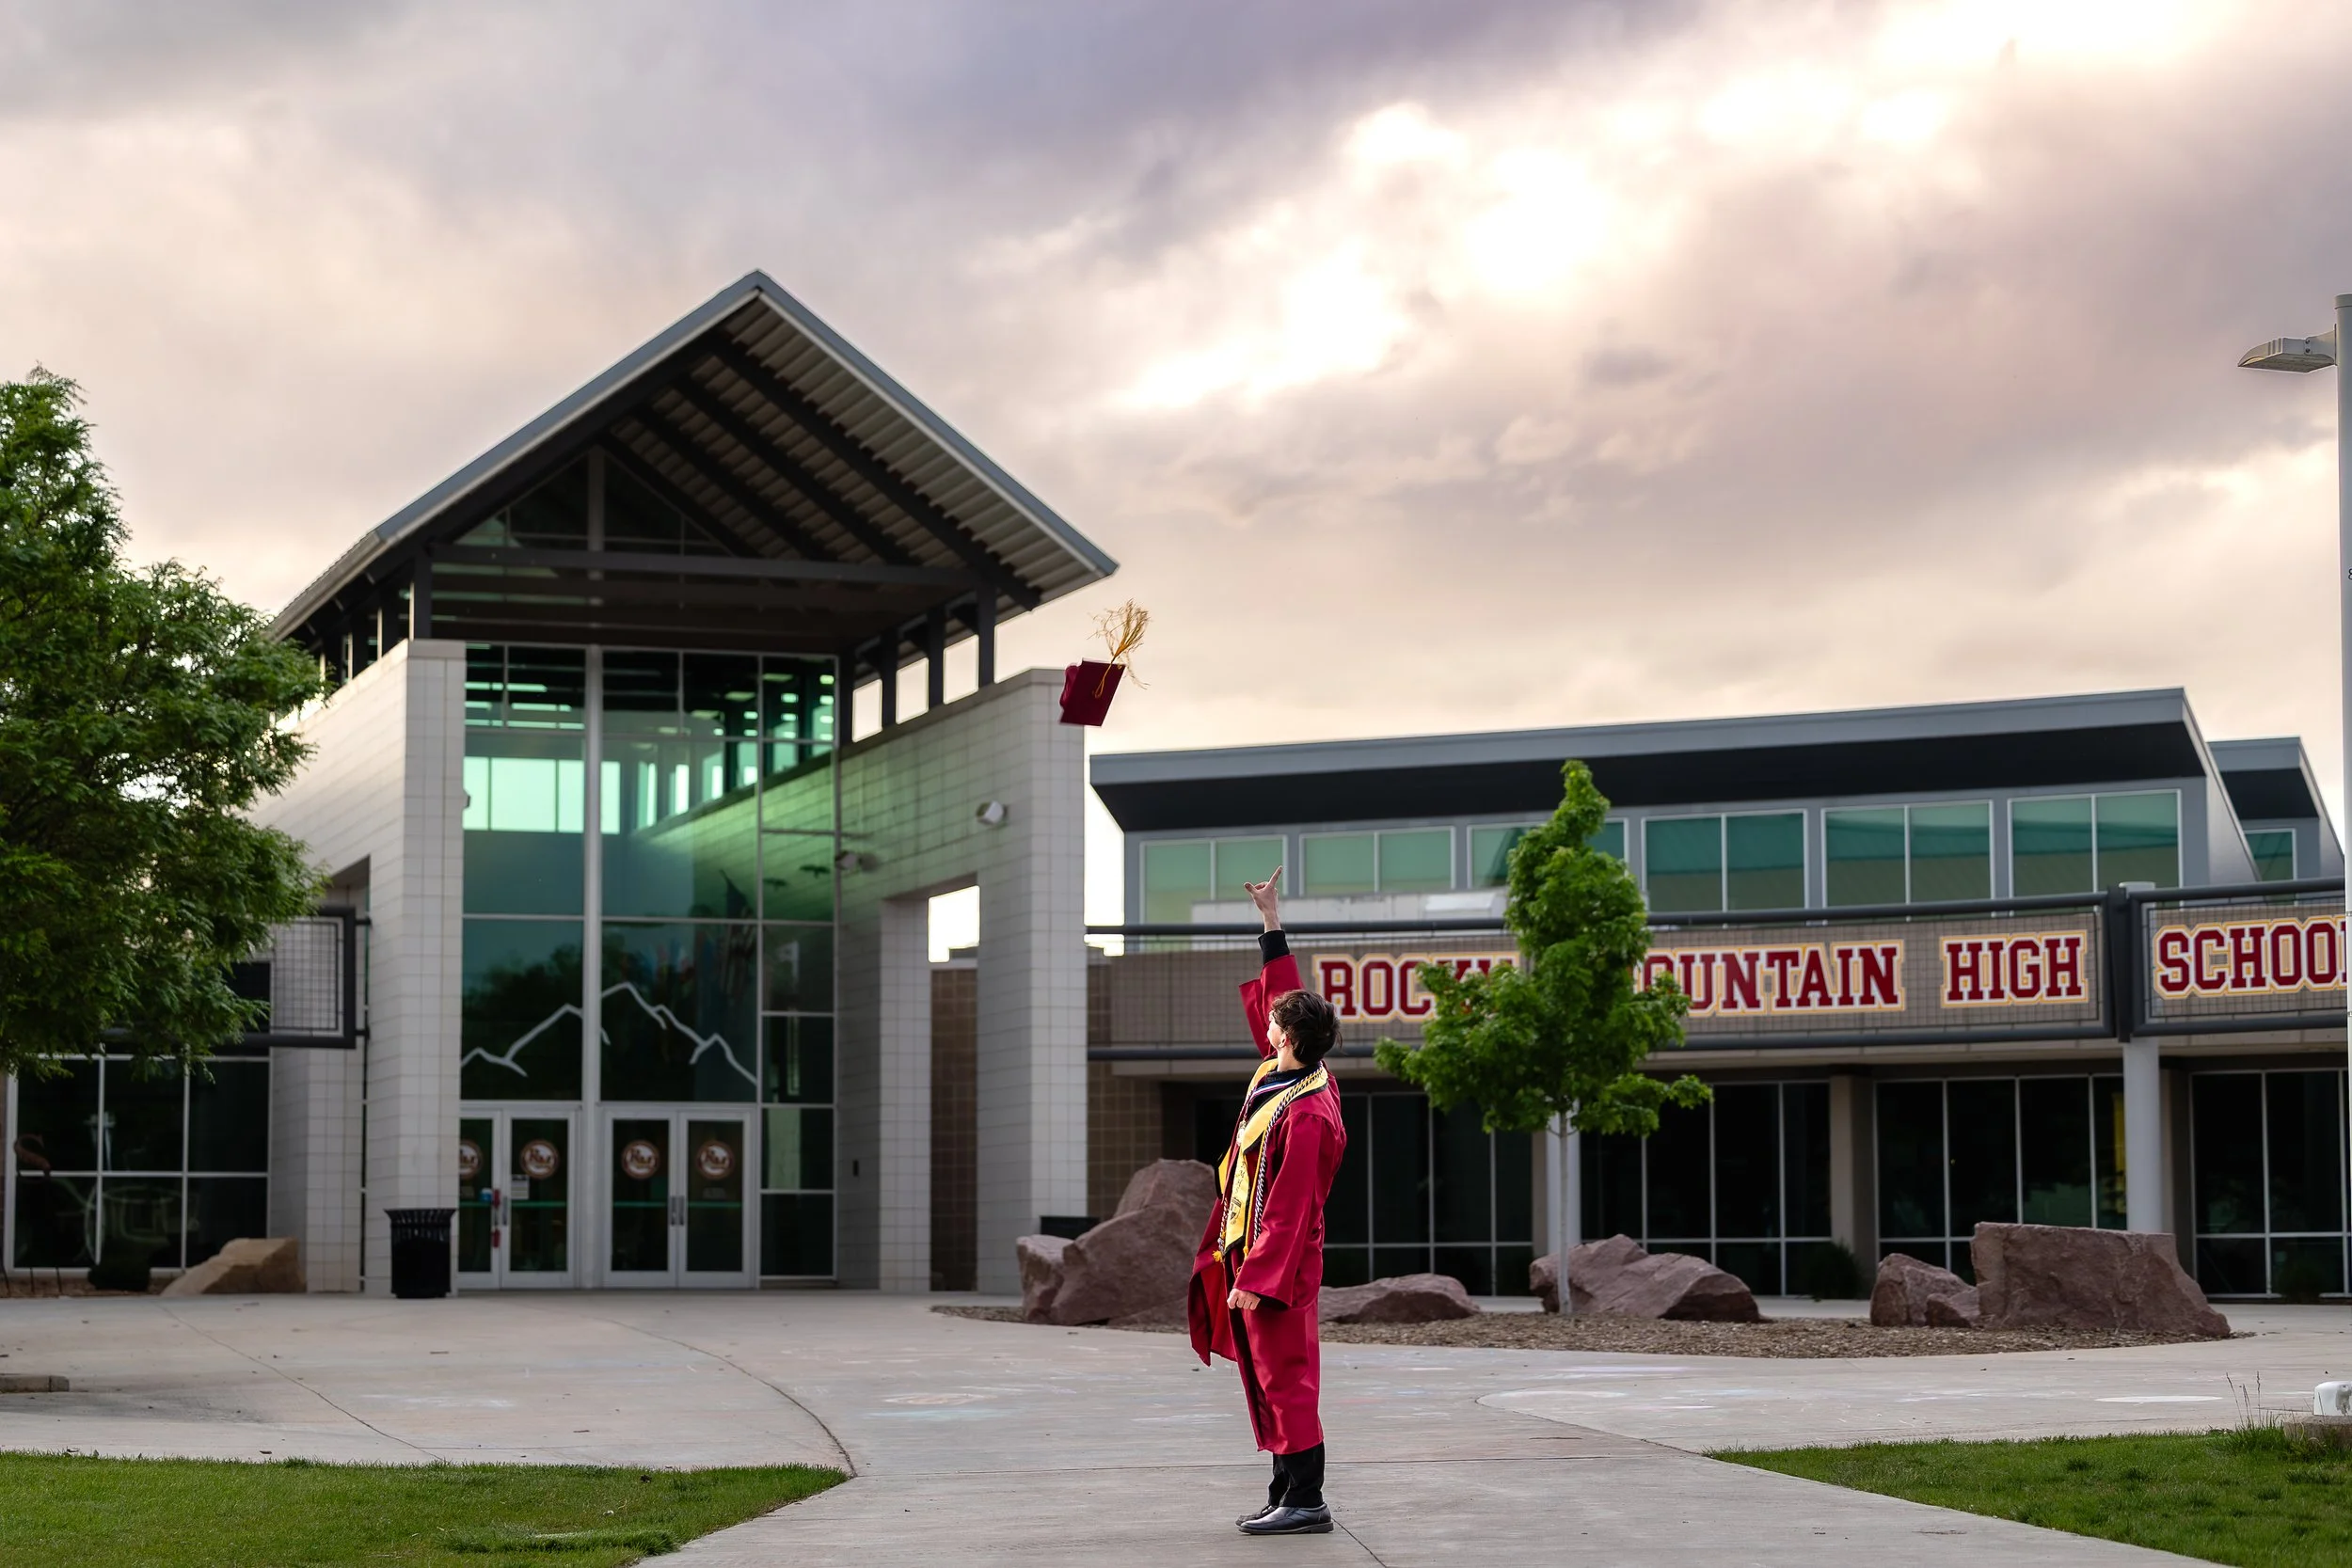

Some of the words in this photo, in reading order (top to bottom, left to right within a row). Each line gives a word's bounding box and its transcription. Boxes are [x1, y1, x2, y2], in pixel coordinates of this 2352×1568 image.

[1315, 954, 1518, 1021] ROC
[1631, 942, 1902, 1016] OUNTAIN
[1942, 932, 2087, 1006] HIGH
[2155, 916, 2346, 997] SCHOO
